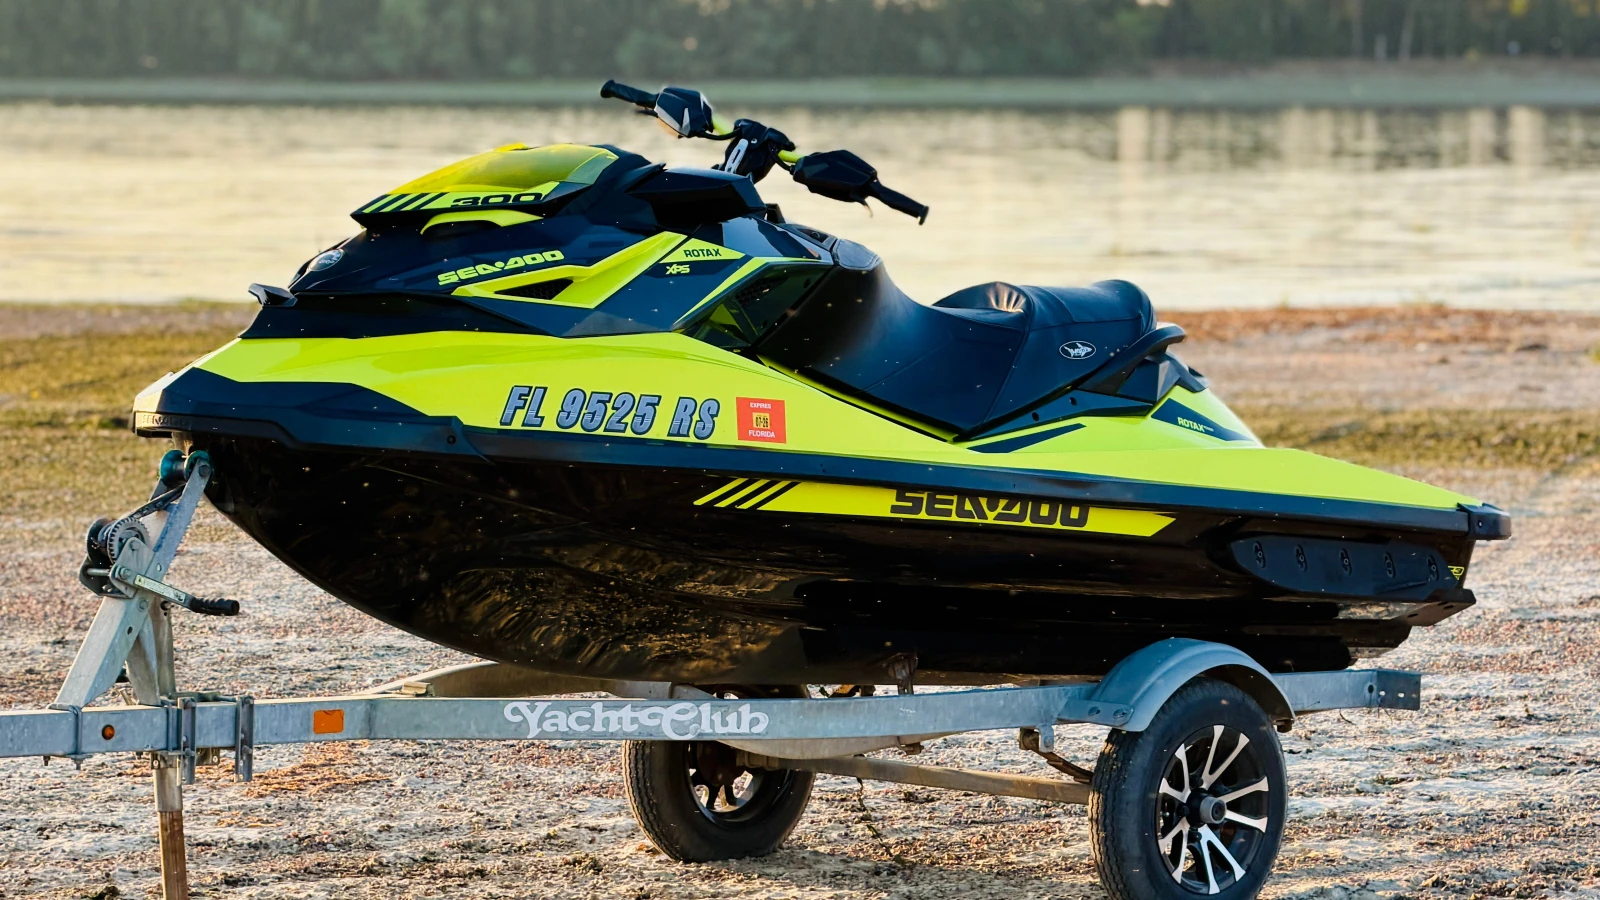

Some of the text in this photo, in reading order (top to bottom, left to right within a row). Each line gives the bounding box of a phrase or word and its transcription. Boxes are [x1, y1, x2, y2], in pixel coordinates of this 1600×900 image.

[450, 193, 543, 208] 300
[683, 248, 722, 257] ROTAX
[665, 263, 690, 275] XPS
[500, 385, 720, 440] FL 9525 RS
[755, 416, 769, 428] 07-26
[1177, 416, 1205, 432] ROTAX
[748, 429, 776, 438] FLORIDA
